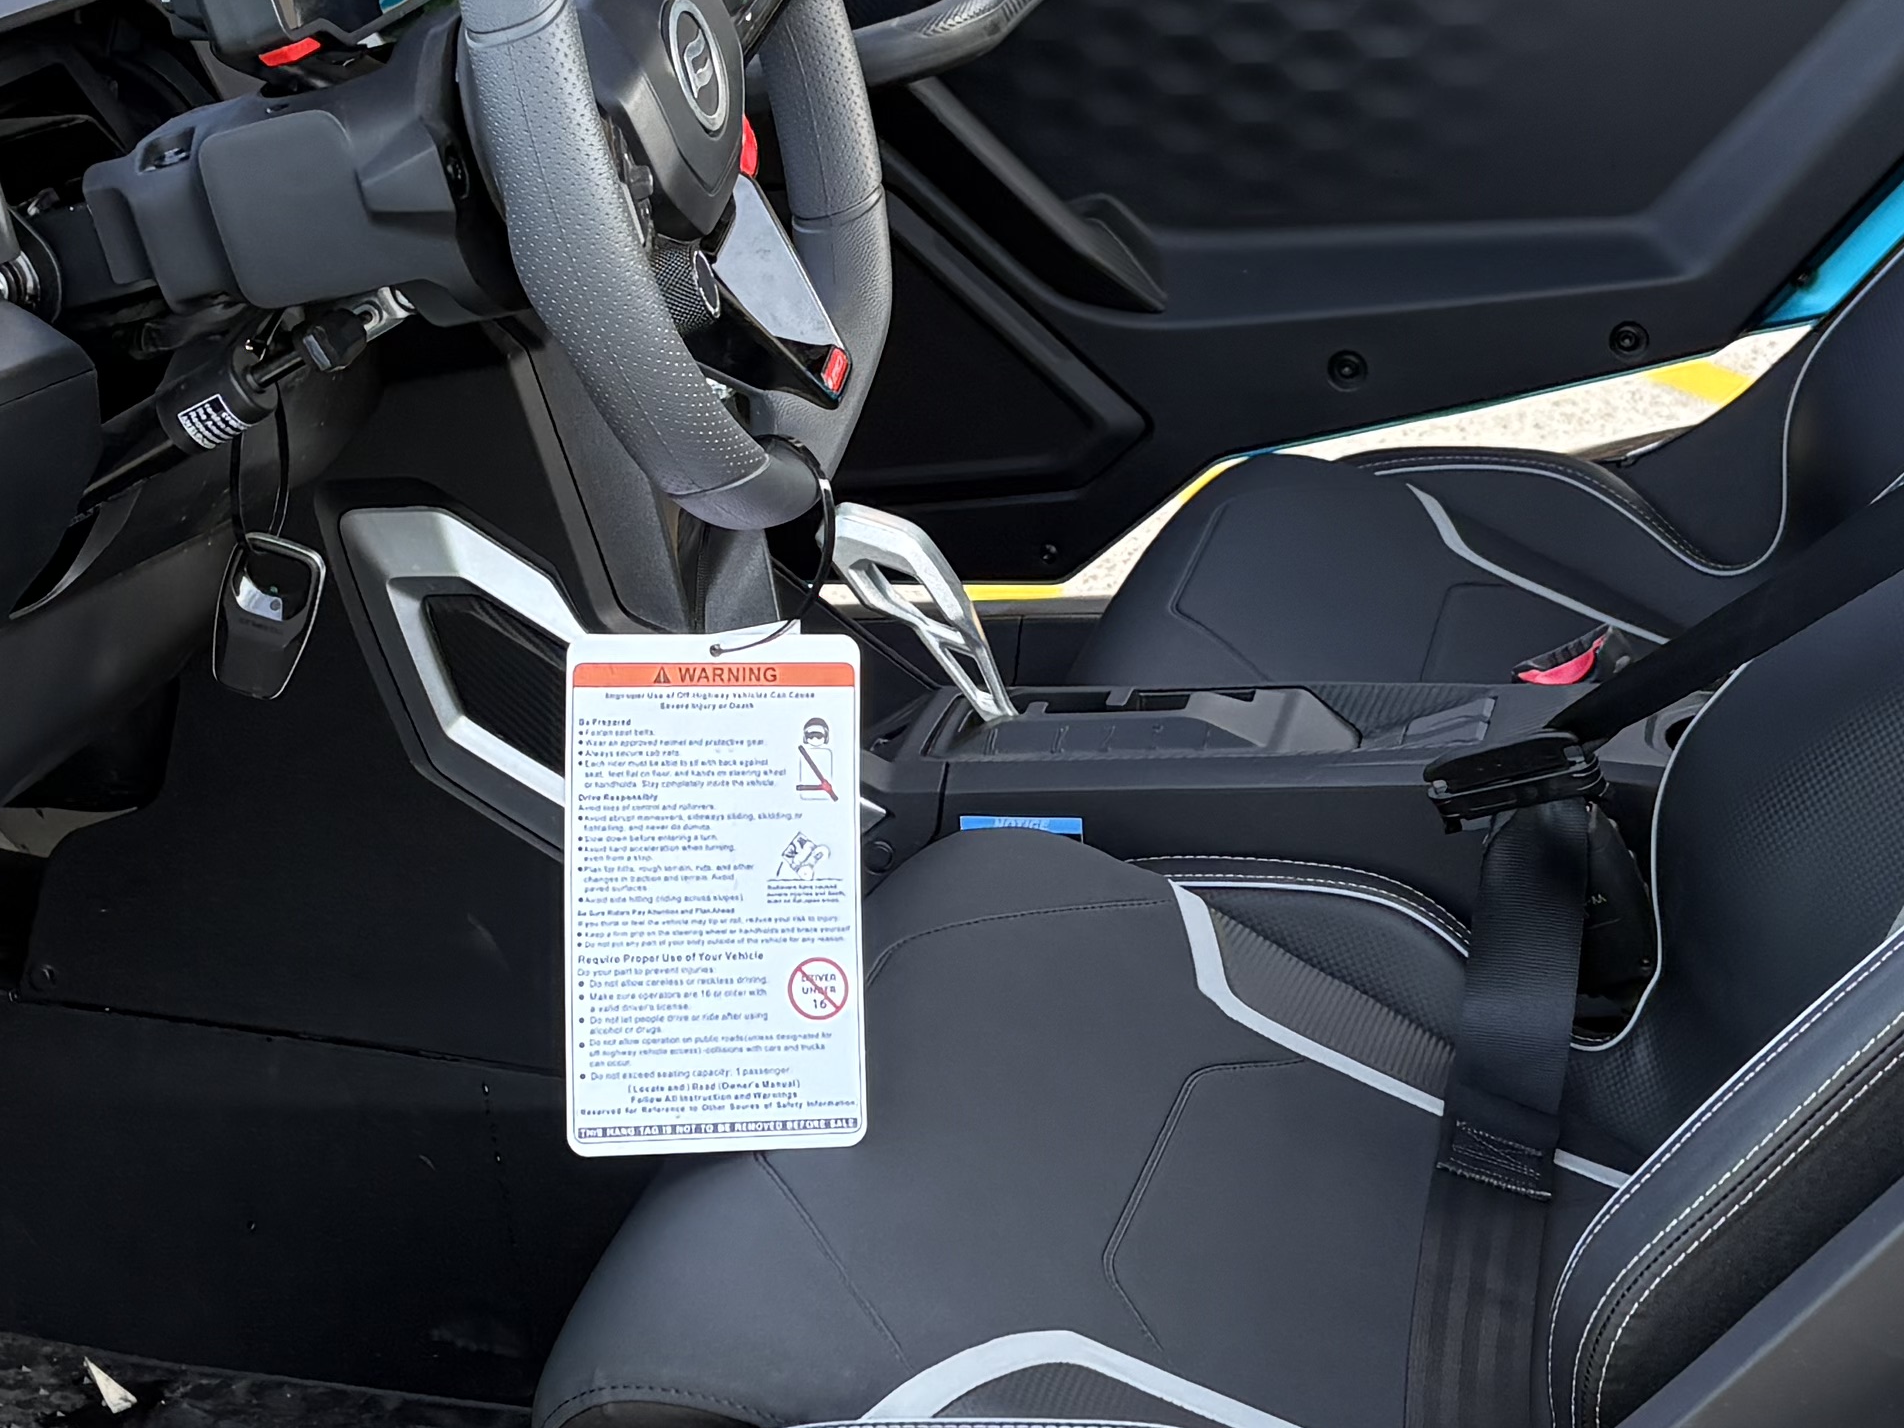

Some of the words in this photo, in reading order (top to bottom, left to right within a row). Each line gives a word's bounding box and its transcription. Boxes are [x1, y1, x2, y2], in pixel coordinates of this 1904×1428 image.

[678, 666, 778, 684] WARNING
[578, 956, 620, 964] Require
[623, 955, 659, 963] Proper
[662, 954, 682, 962] Use
[685, 953, 695, 961] of
[698, 953, 721, 961] Your
[725, 952, 763, 960] Vehicle
[812, 997, 828, 1010] 16
